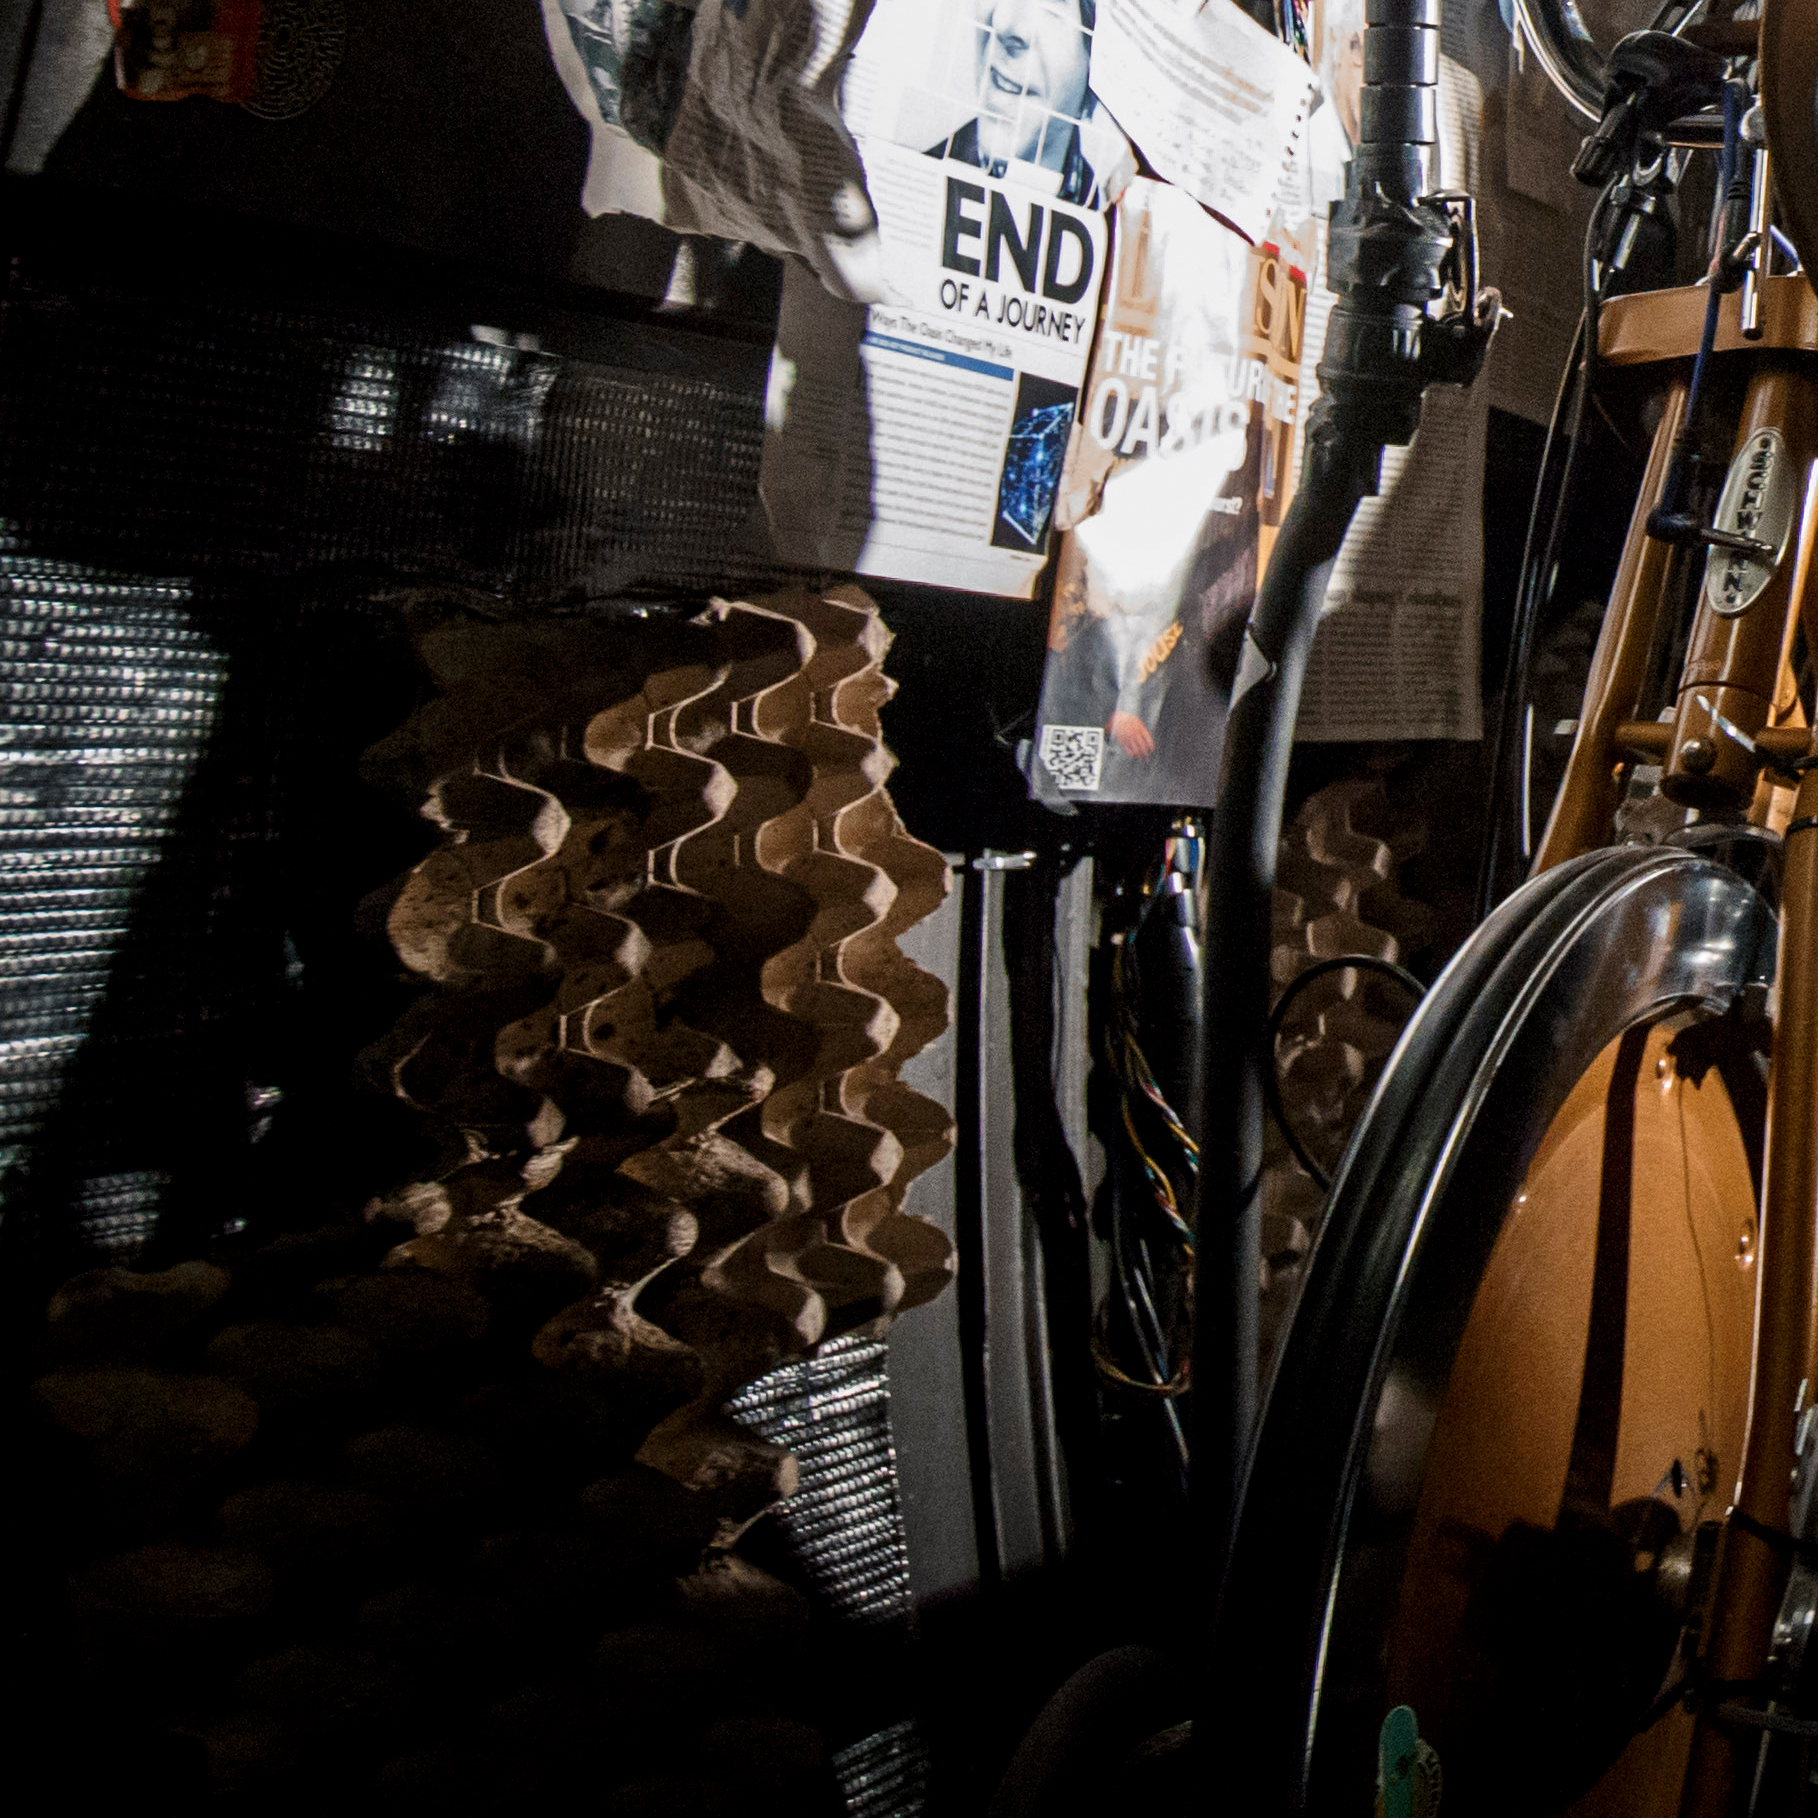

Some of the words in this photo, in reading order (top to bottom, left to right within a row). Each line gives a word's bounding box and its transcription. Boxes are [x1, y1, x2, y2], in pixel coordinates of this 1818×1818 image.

[941, 175, 1095, 306] END
[939, 278, 970, 313] OF
[974, 290, 991, 320] A
[996, 294, 1086, 344] JOURNEY
[1103, 330, 1161, 382] THE
